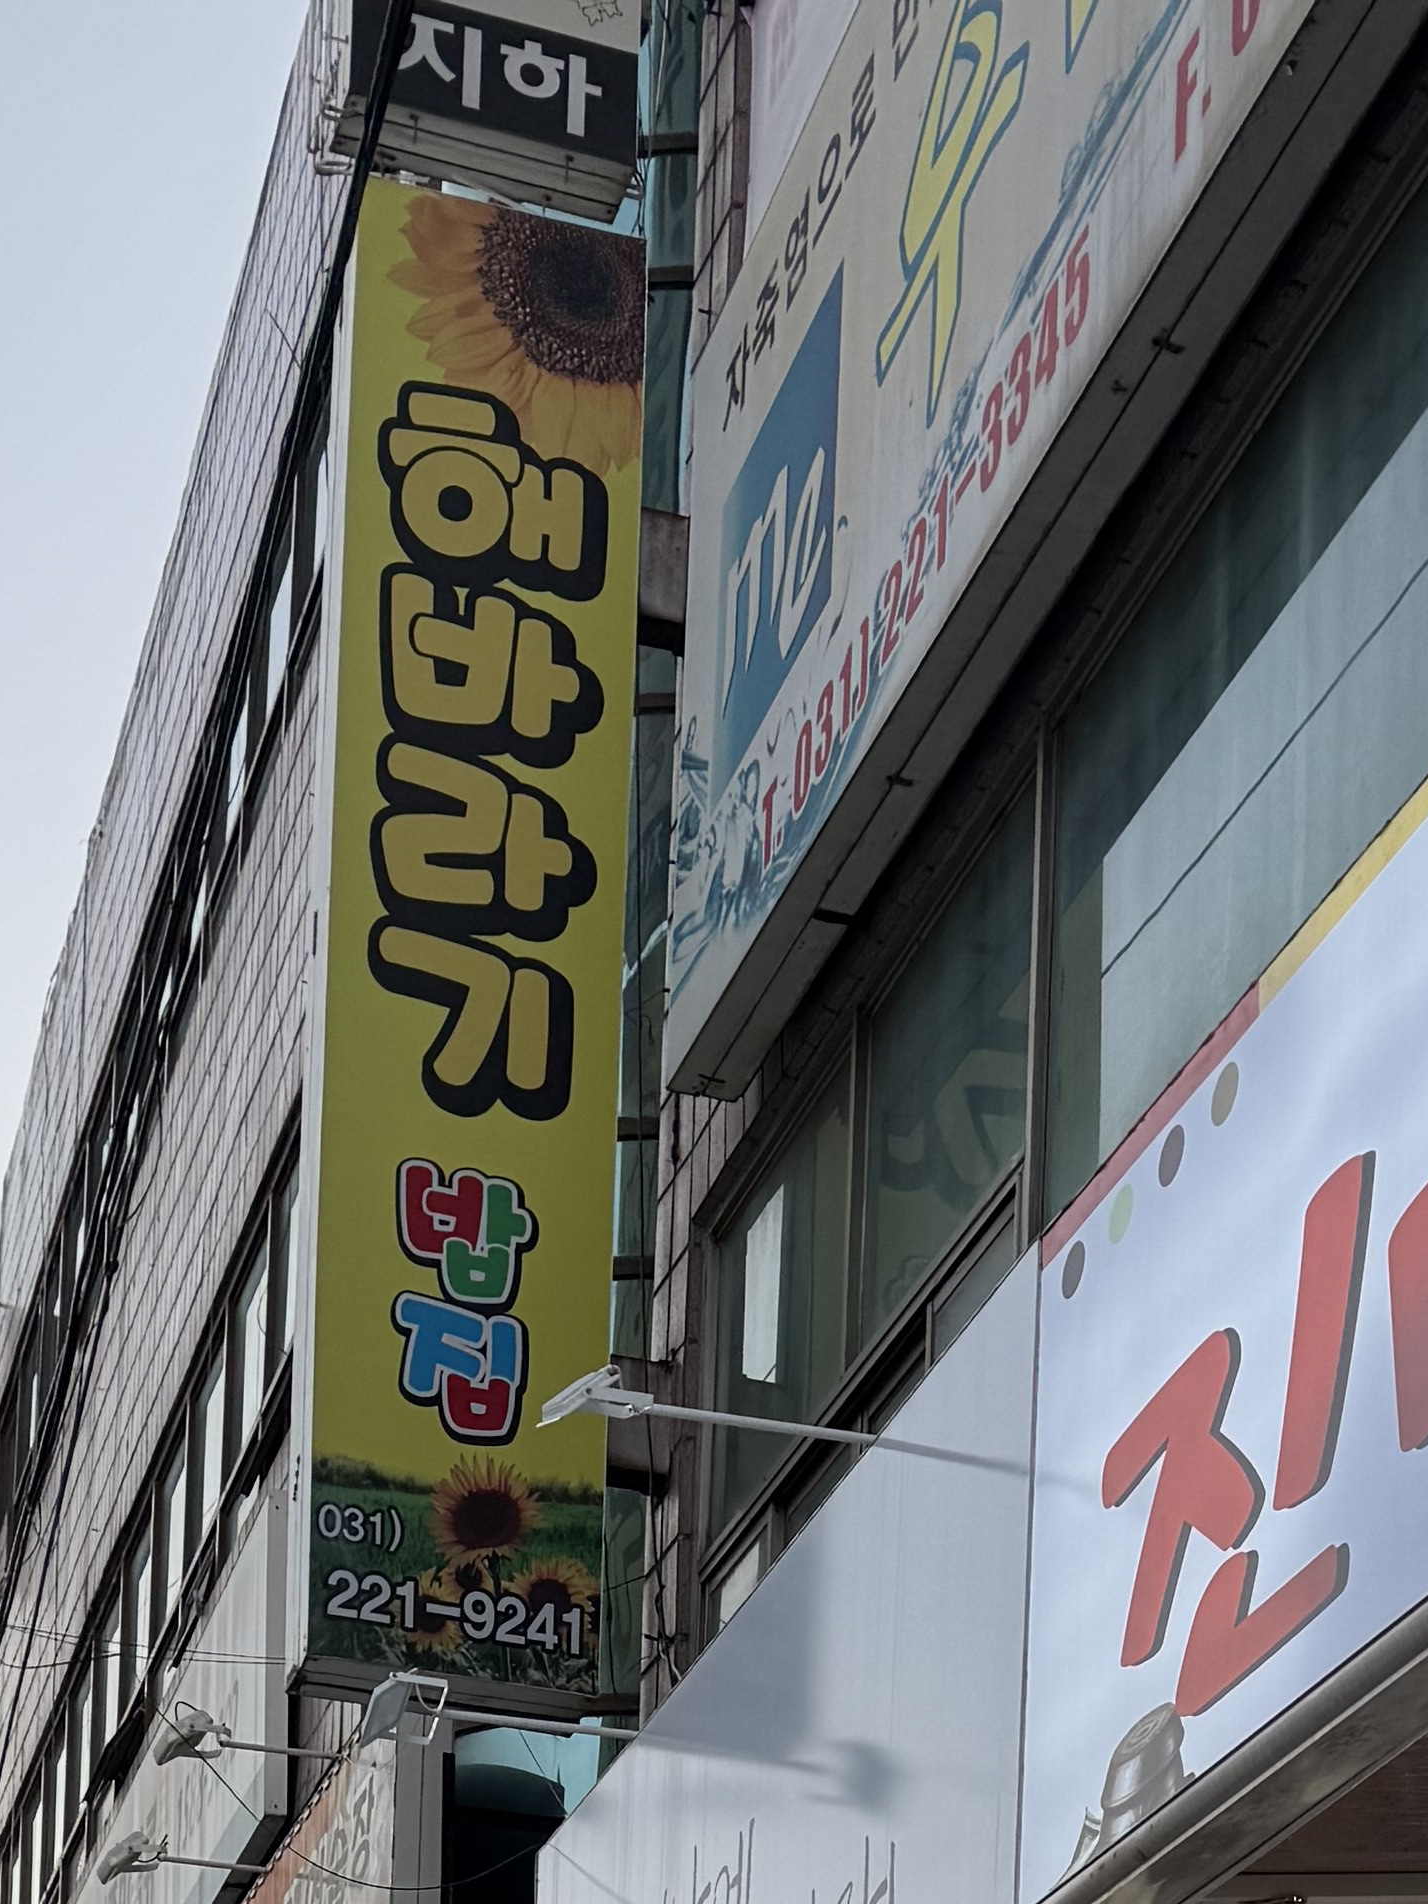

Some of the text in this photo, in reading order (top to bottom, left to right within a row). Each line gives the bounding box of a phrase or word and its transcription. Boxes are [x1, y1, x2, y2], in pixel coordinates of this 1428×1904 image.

[396, 17, 602, 138] 지하
[368, 380, 609, 1121] 해바라기
[391, 1157, 539, 1446] 밥집
[317, 1503, 404, 1554] 031)
[324, 1568, 594, 1658] 221-9241
